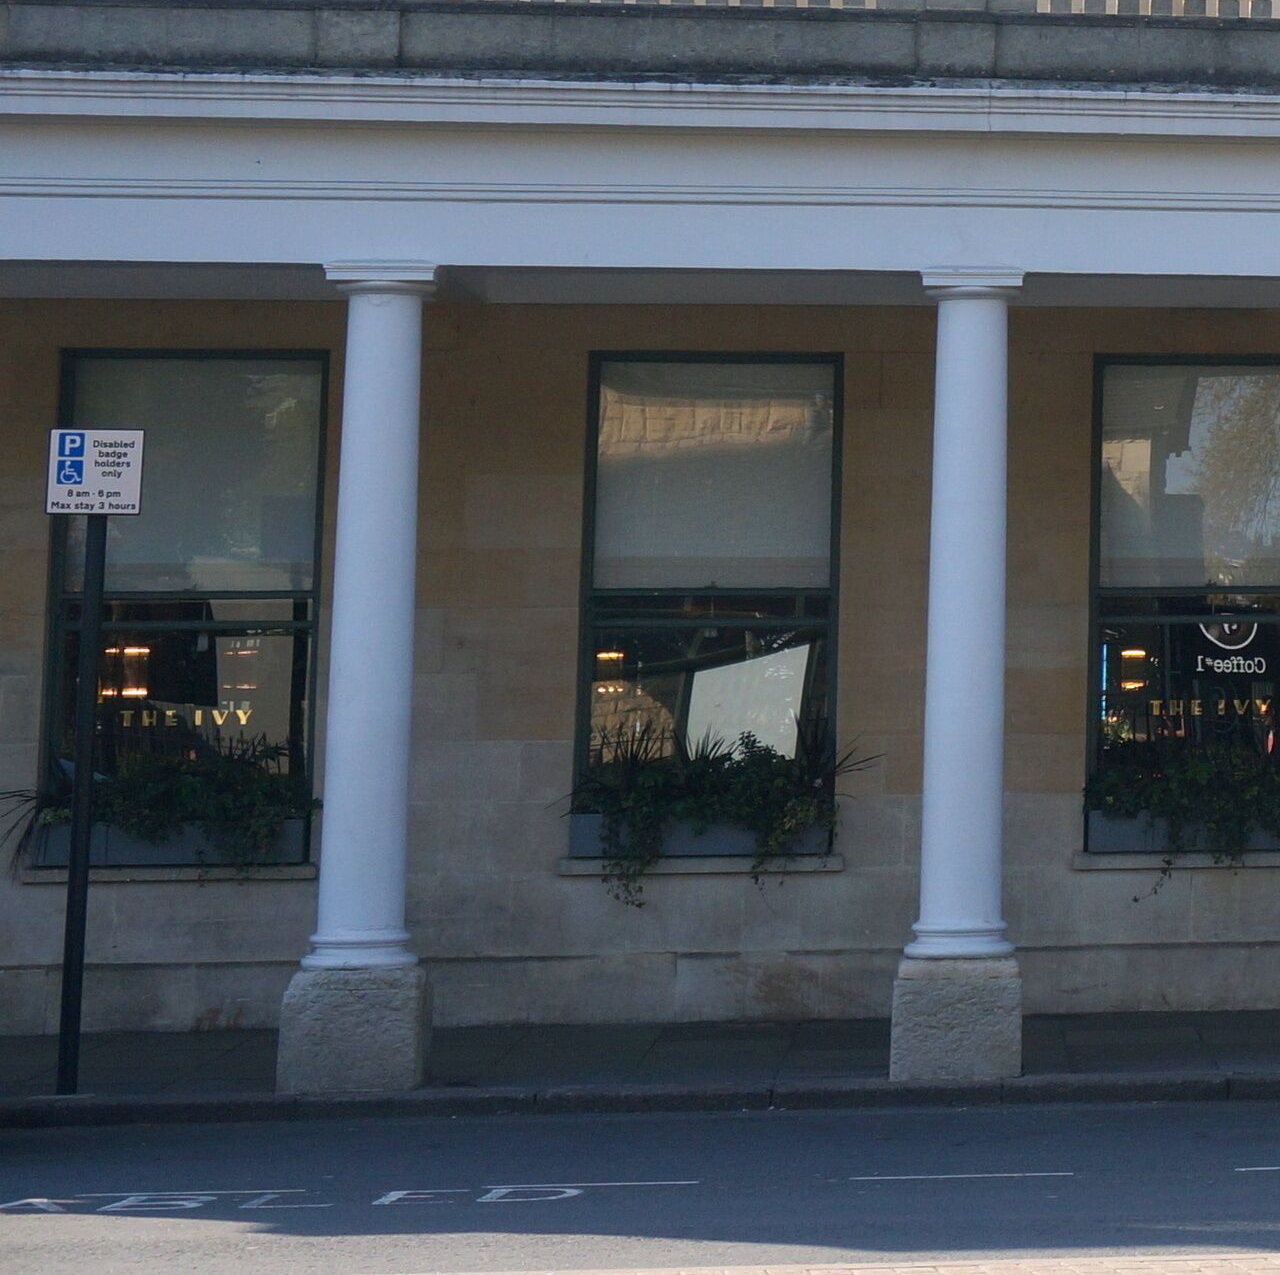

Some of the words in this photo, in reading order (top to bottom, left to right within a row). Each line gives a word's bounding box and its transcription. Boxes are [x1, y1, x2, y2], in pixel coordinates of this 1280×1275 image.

[63, 435, 82, 455] P
[93, 440, 136, 449] Disabled
[98, 450, 129, 459] badge
[94, 460, 132, 468] holders
[101, 469, 123, 479] only
[67, 489, 74, 497] 8
[97, 489, 104, 497] 6
[106, 490, 121, 499] pm
[50, 501, 72, 510] Max
[75, 502, 95, 511] stay
[98, 502, 105, 510] 3
[108, 502, 136, 510] hours
[1150, 699, 1202, 716] THE
[1217, 699, 1272, 716] IVY
[120, 710, 178, 727] THE
[195, 709, 253, 726] IVY
